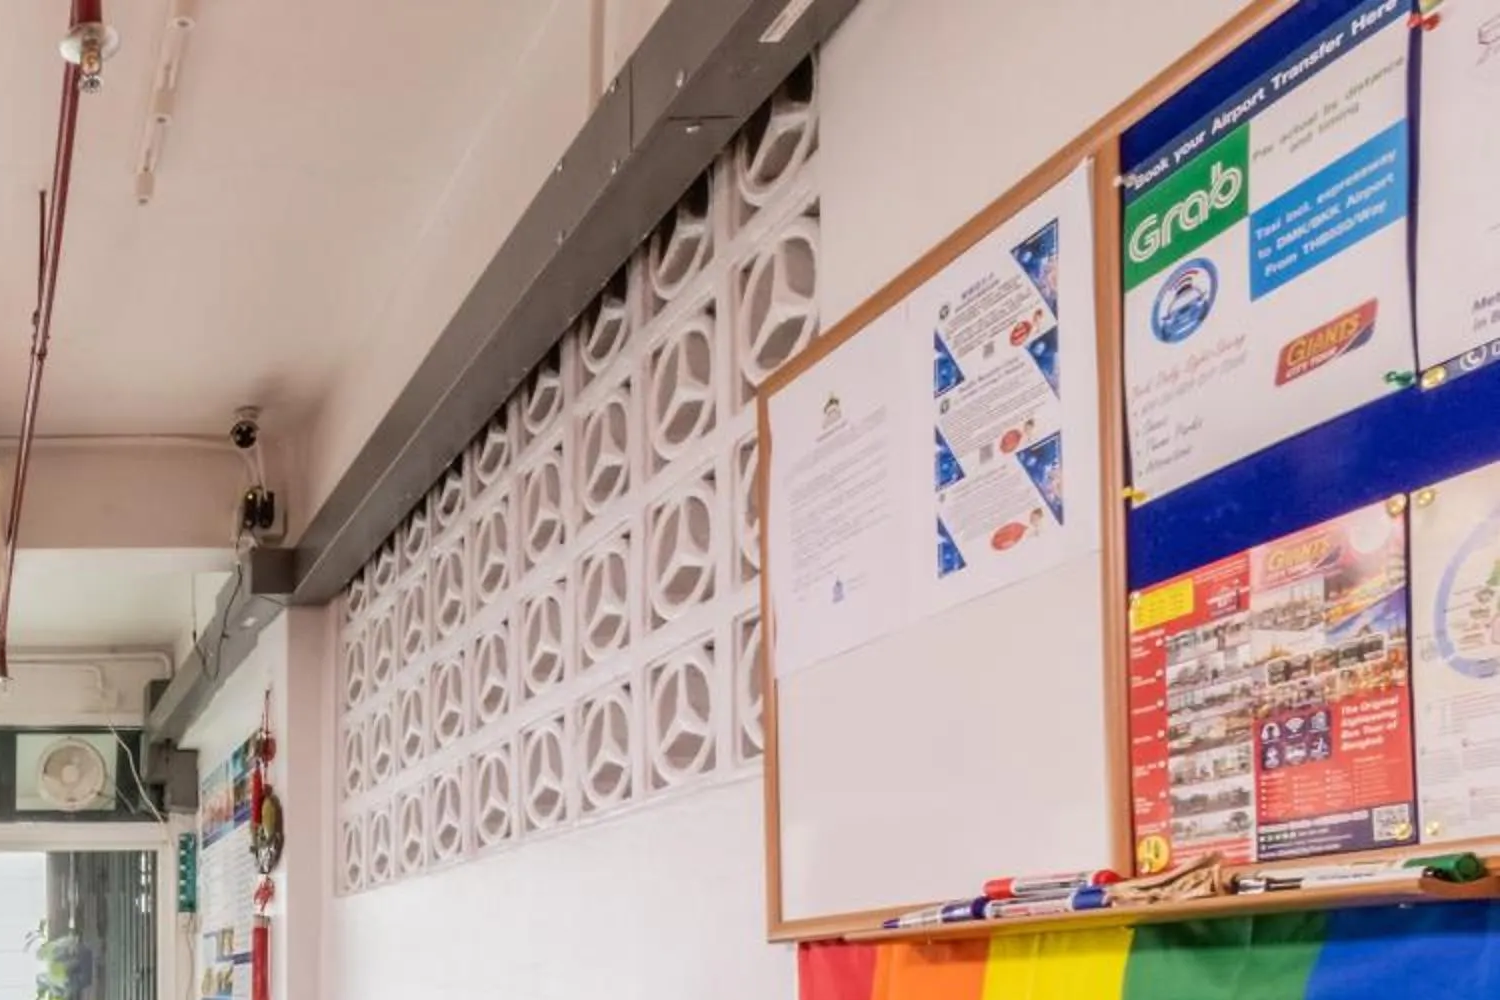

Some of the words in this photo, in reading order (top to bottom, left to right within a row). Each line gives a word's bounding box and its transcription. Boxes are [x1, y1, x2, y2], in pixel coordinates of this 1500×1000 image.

[1173, 131, 1206, 163] your
[1211, 87, 1266, 135] Airport
[1270, 33, 1344, 91] Transfer
[1351, 0, 1397, 36] Here
[1129, 161, 1242, 263] Grab
[1346, 172, 1395, 208] Airport
[1264, 252, 1298, 277] From
